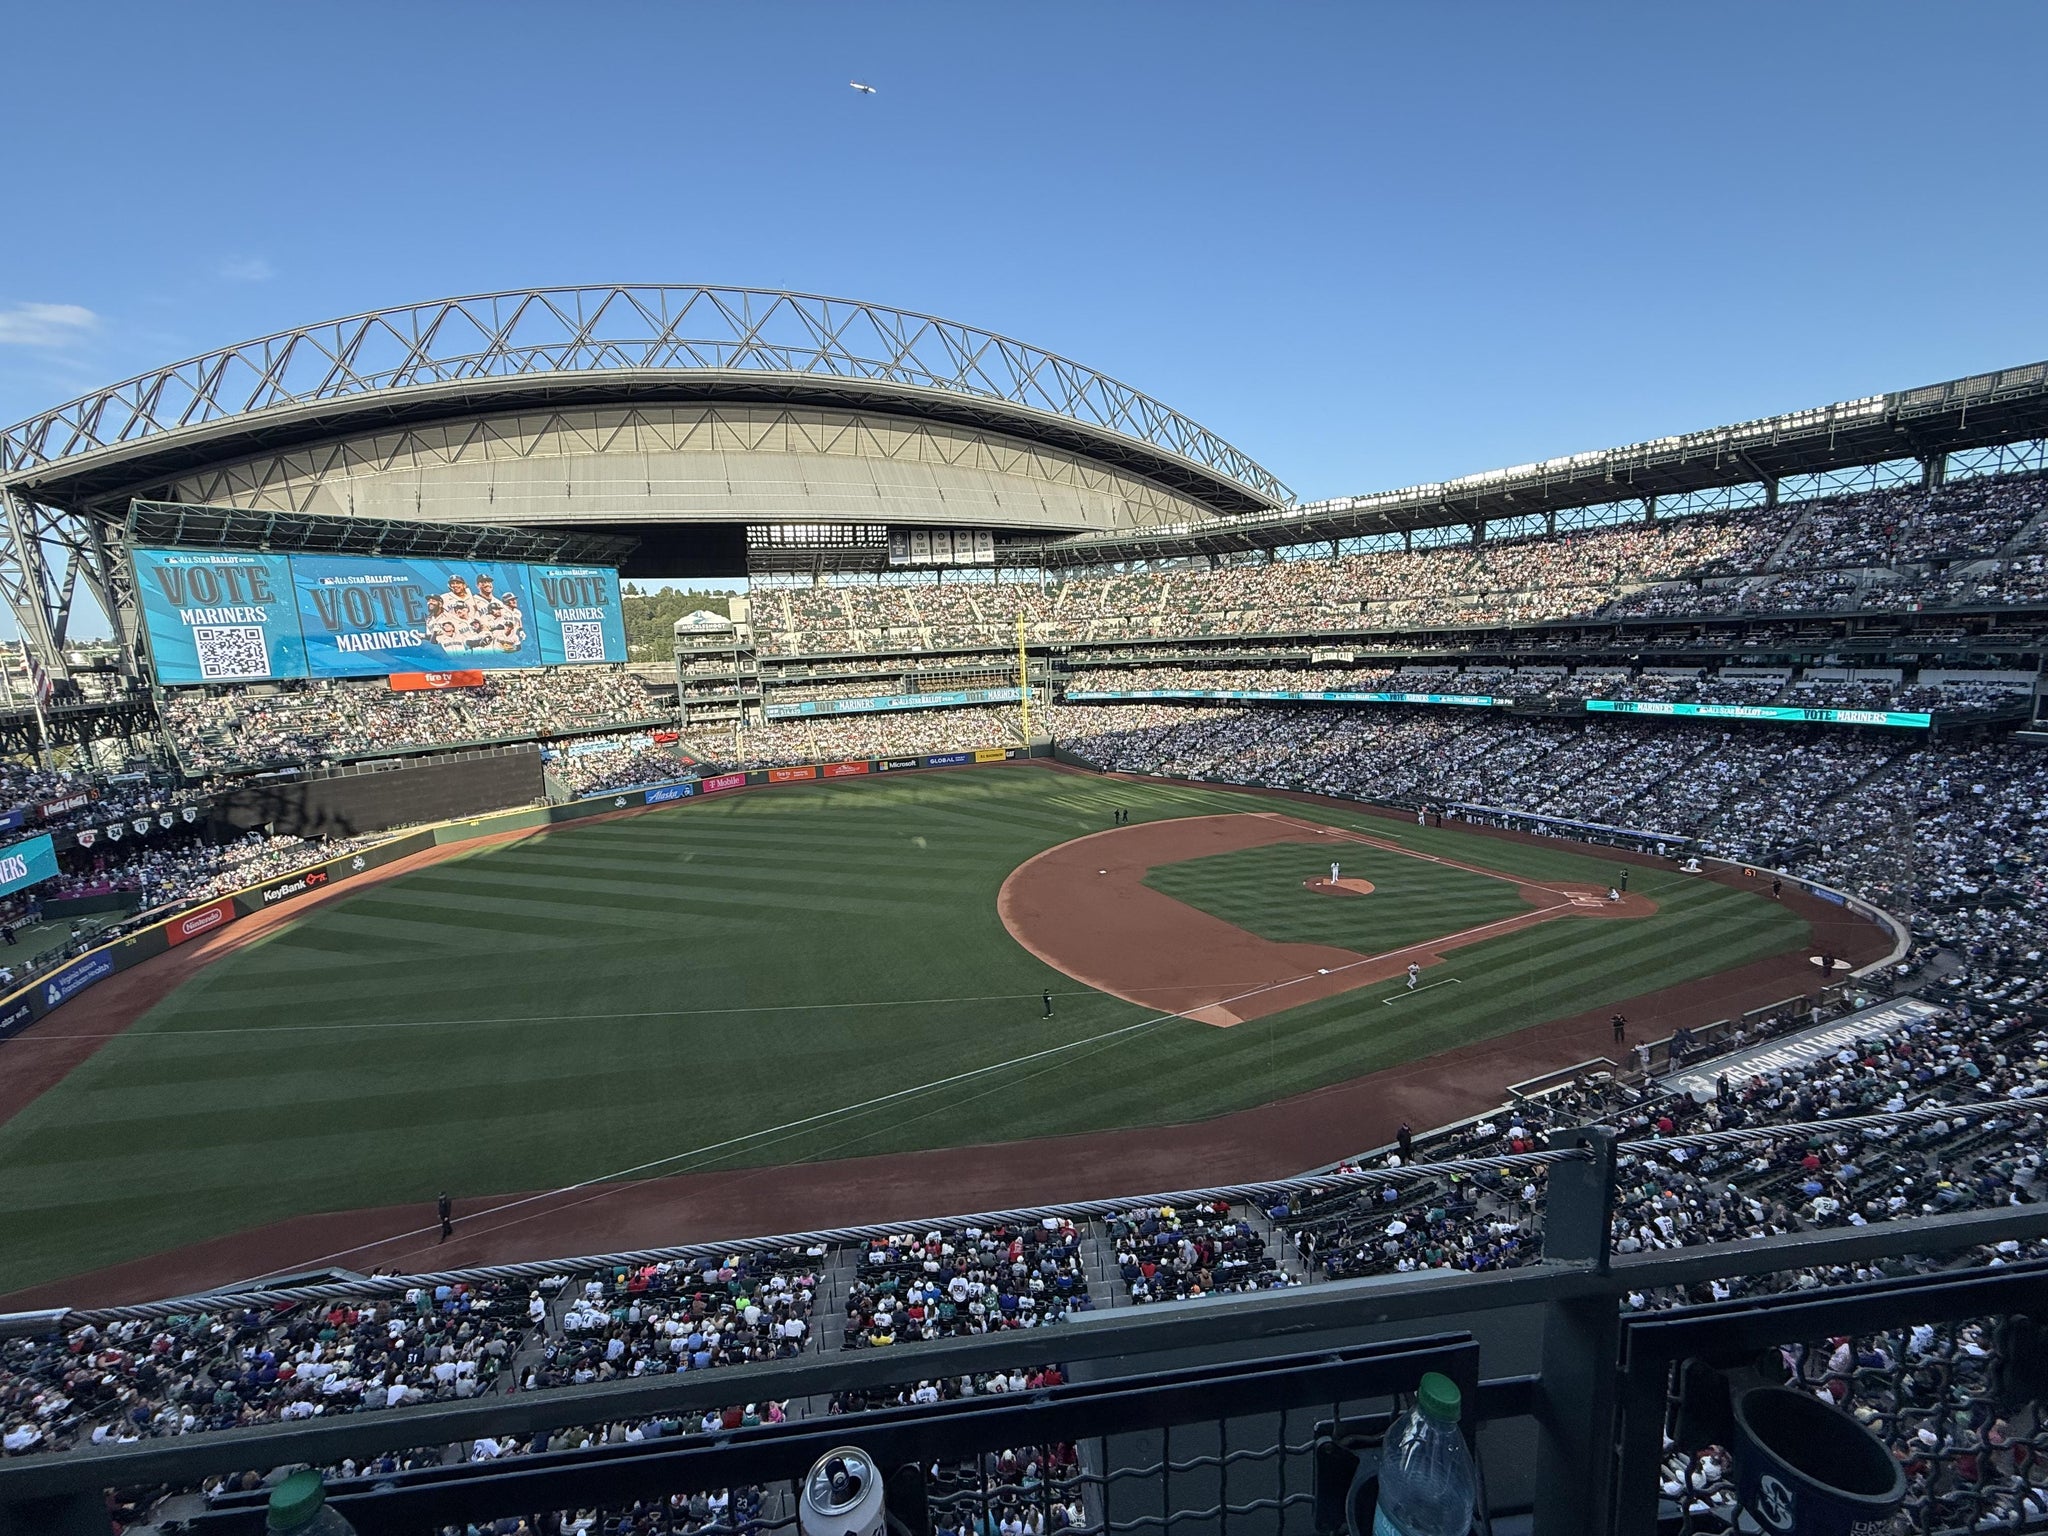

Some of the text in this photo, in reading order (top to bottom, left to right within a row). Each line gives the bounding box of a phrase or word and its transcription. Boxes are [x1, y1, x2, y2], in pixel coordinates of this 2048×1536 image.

[210, 556, 240, 564] BALLOT
[365, 575, 393, 584] BALLOT
[152, 565, 277, 607] VOTE
[540, 576, 609, 608] VOTE
[308, 583, 427, 633] VOTE
[179, 606, 268, 626] MARINERS
[554, 607, 604, 622] MARINERS
[335, 629, 422, 653] MARINERS
[1338, 651, 1354, 663] CLUB
[425, 673, 452, 682] fire tv
[921, 696, 942, 704] BALLOT
[965, 689, 1019, 701] VOTE MARINERS
[814, 701, 836, 713] VOTE
[839, 699, 875, 711] MARINERS
[1613, 702, 1674, 713] VOTE MARINERS
[1734, 707, 1762, 716] BALLOT
[1803, 709, 1887, 723] VOTE MARINERS
[889, 759, 917, 769] Microsoft
[930, 757, 955, 765] GLOBAL
[716, 776, 740, 787] Mobile
[648, 789, 680, 802] Alaska
[138, 823, 146, 831] 11
[163, 817, 171, 825] 51
[111, 829, 121, 838] 24
[263, 879, 307, 902] KeyBank
[186, 912, 220, 931] Nintendo
[59, 960, 97, 986] Virginia Mason
[61, 962, 110, 995] Franciscan Health
[1709, 1009, 1912, 1085] WELCOME TO T-MOBILE PARK
[407, 1353, 418, 1363] 51
[737, 1498, 747, 1508] 23
